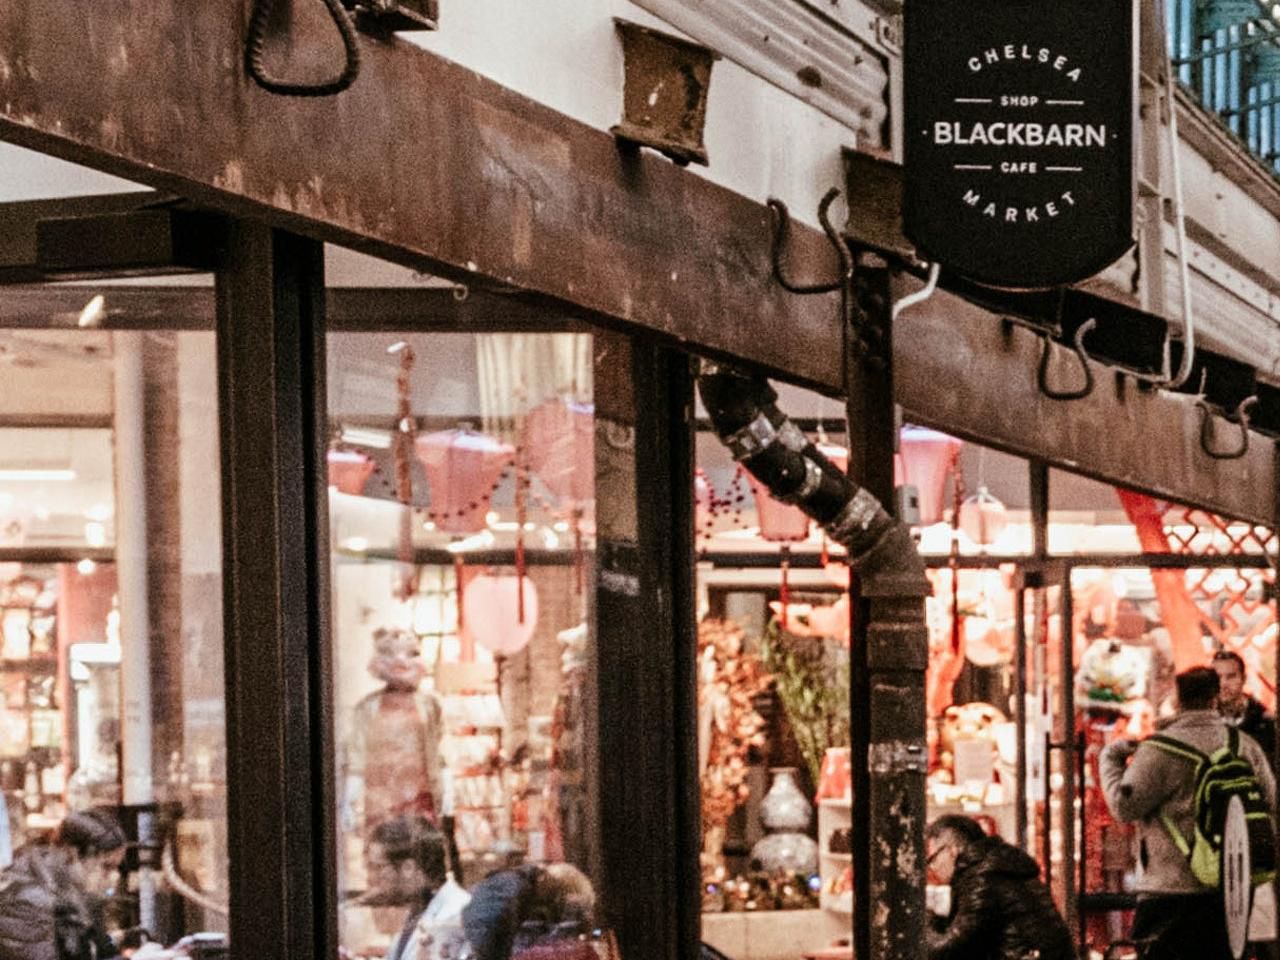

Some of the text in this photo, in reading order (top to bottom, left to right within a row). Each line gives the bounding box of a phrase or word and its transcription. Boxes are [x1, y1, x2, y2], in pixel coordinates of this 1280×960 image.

[968, 42, 1082, 82] CHELSEA
[1000, 95, 1038, 107] SHOP
[934, 121, 1105, 147] BLACKBARN
[1000, 162, 1038, 174] CAFE
[962, 189, 1076, 223] MARKET
